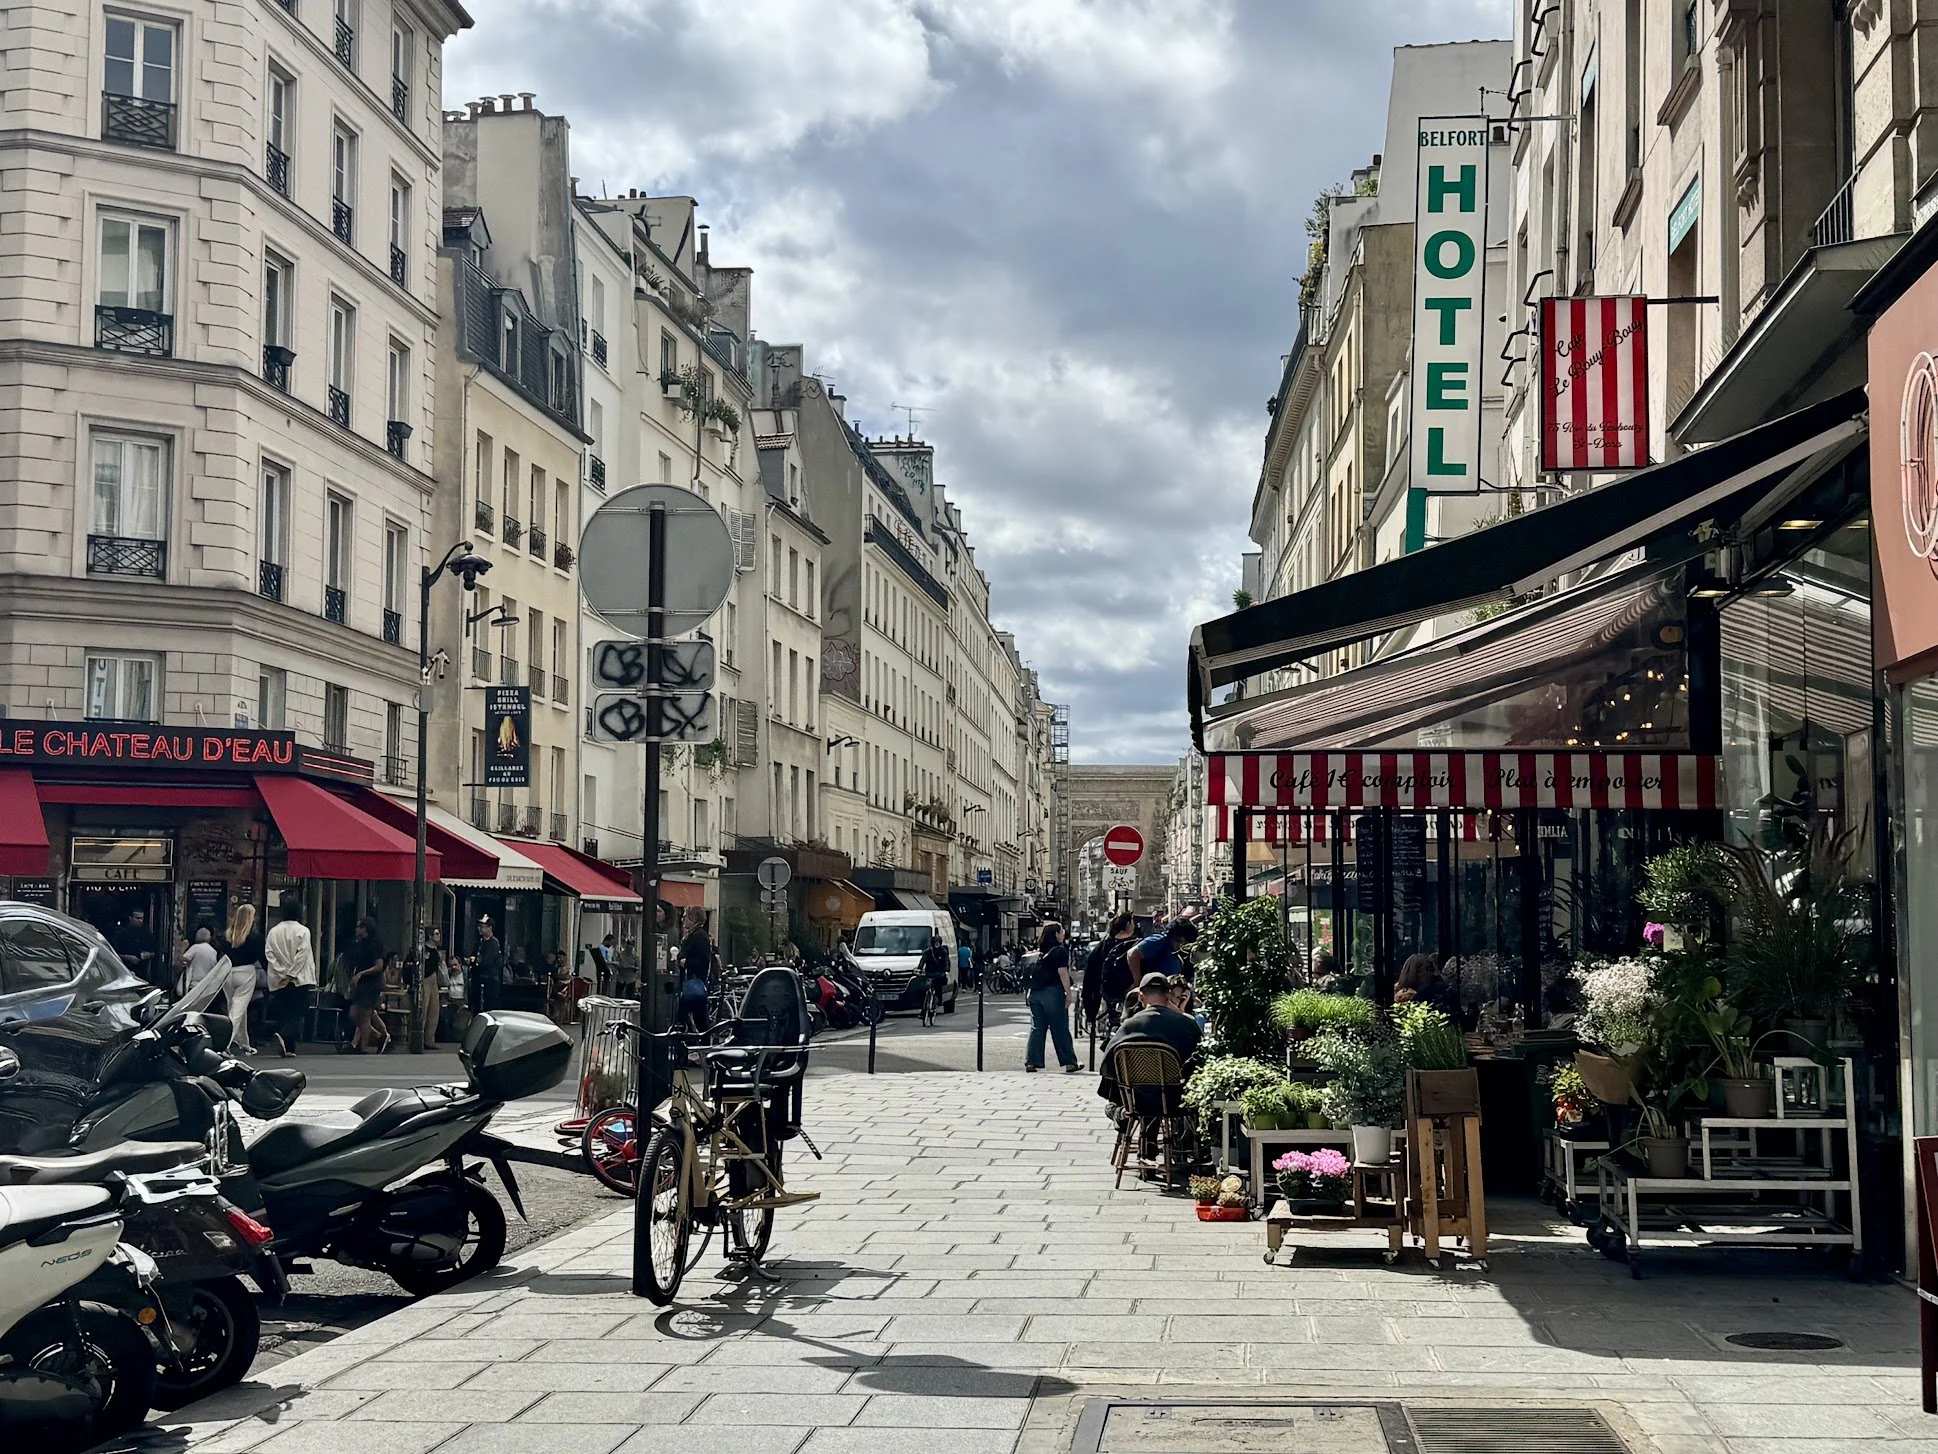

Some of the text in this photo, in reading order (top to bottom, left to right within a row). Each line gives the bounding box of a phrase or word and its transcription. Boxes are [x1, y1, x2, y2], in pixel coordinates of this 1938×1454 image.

[1420, 130, 1487, 147] BELFORT
[1423, 164, 1476, 476] HOTEL
[1549, 377, 1570, 397] Le
[0, 730, 293, 764] LE CHATEAU D'EAU
[1269, 769, 1319, 795] Café
[1327, 768, 1356, 788] 1€
[1362, 771, 1454, 794] comptoir
[1110, 867, 1128, 875] SAUF
